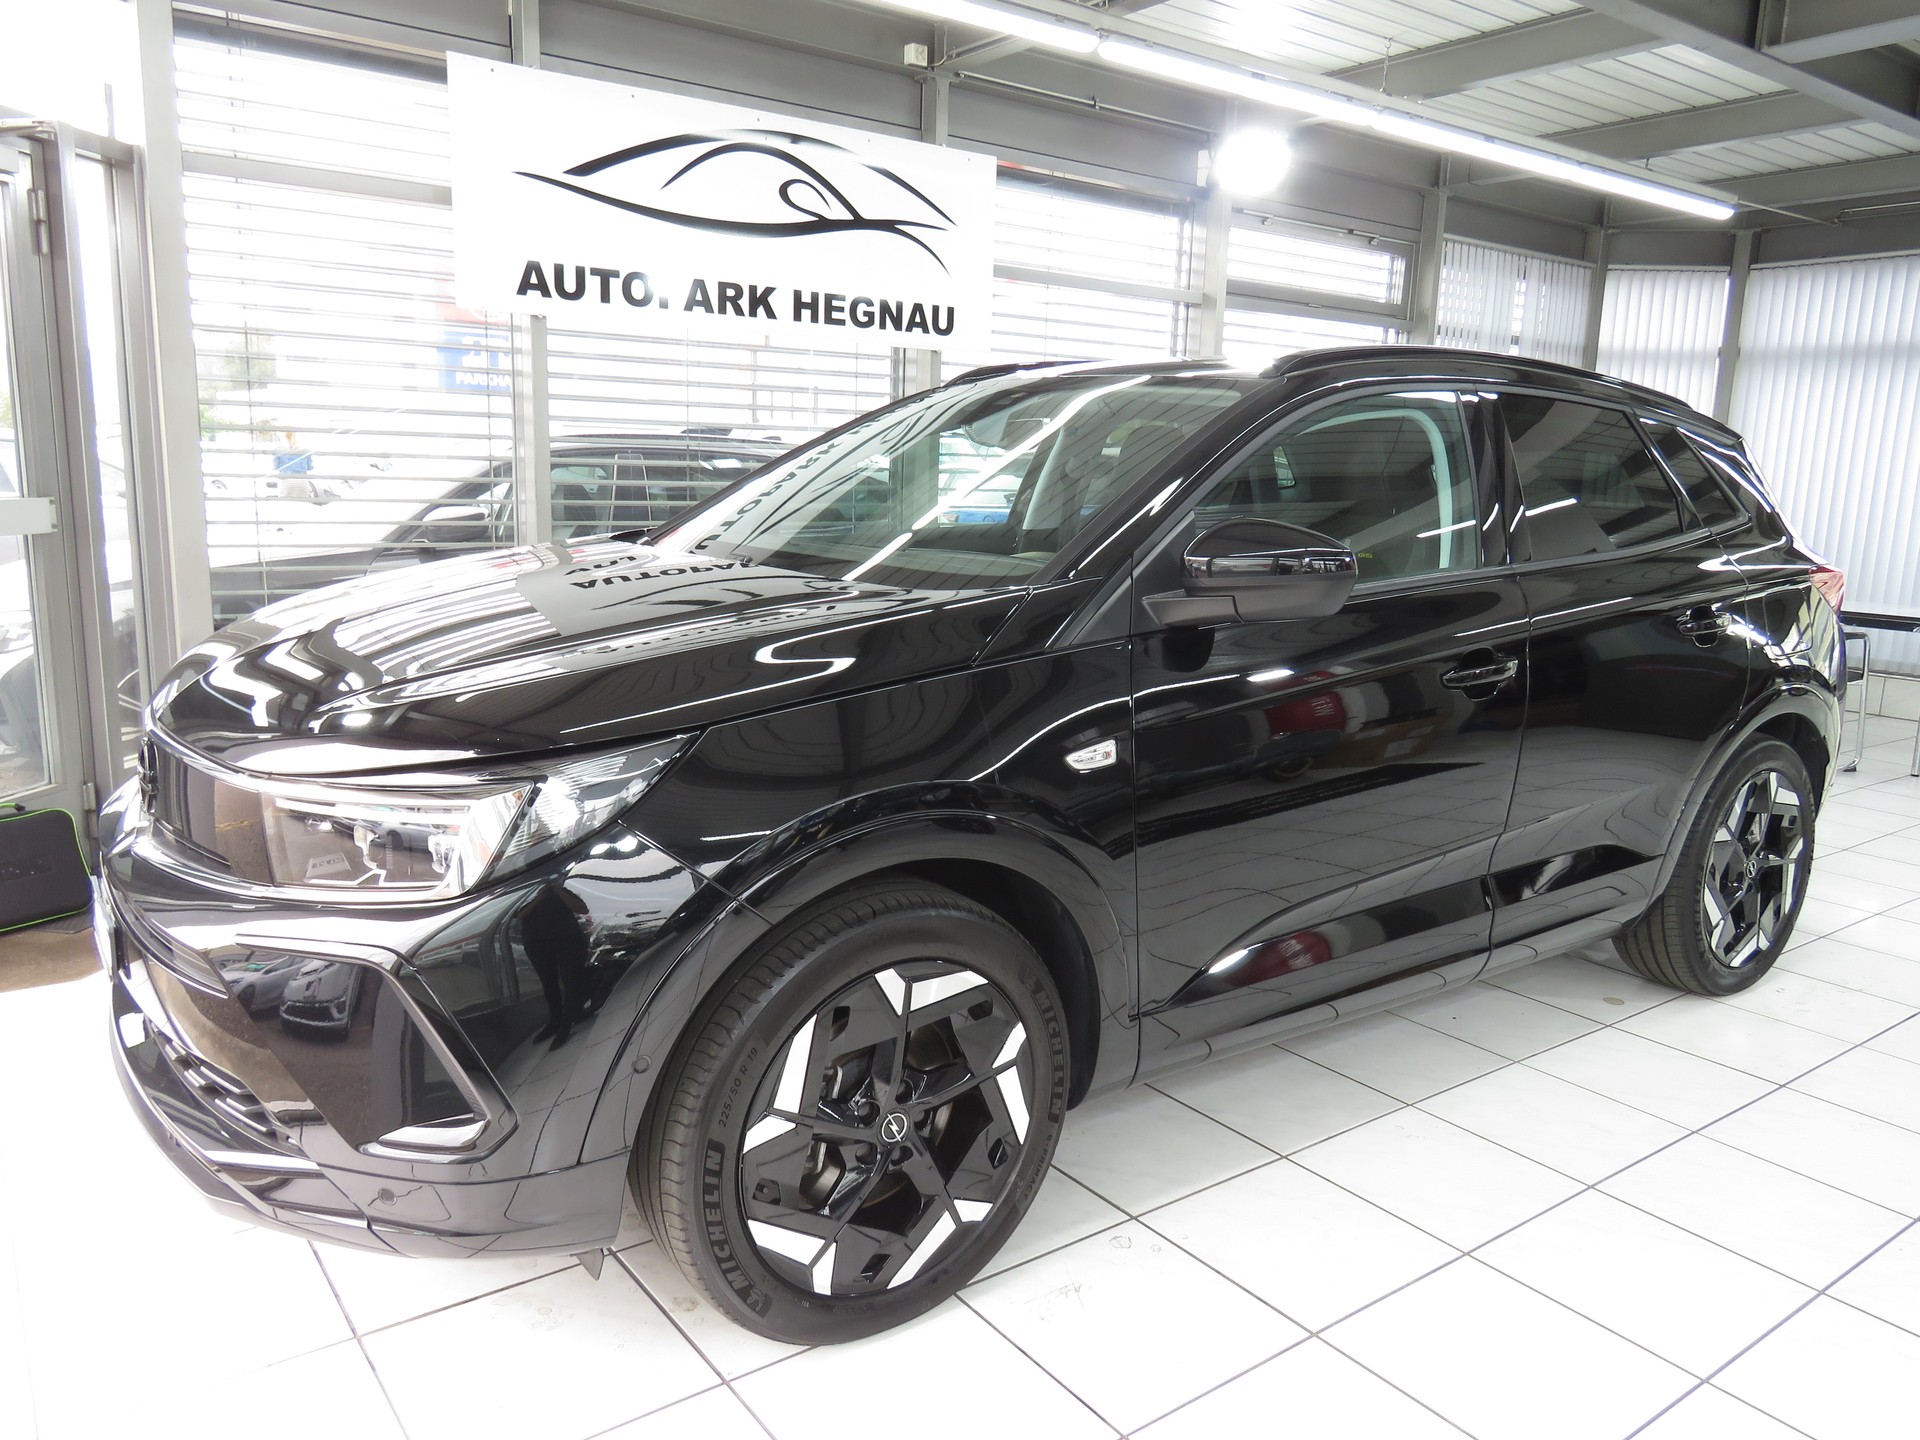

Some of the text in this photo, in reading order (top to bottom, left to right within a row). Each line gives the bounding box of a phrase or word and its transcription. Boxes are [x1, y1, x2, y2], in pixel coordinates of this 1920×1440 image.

[793, 290, 955, 336] HEGNAU
[719, 1047, 758, 1128] 225/50 R 19
[1035, 987, 1064, 1118] MICHELIN
[704, 1149, 750, 1290] MICHELIN
